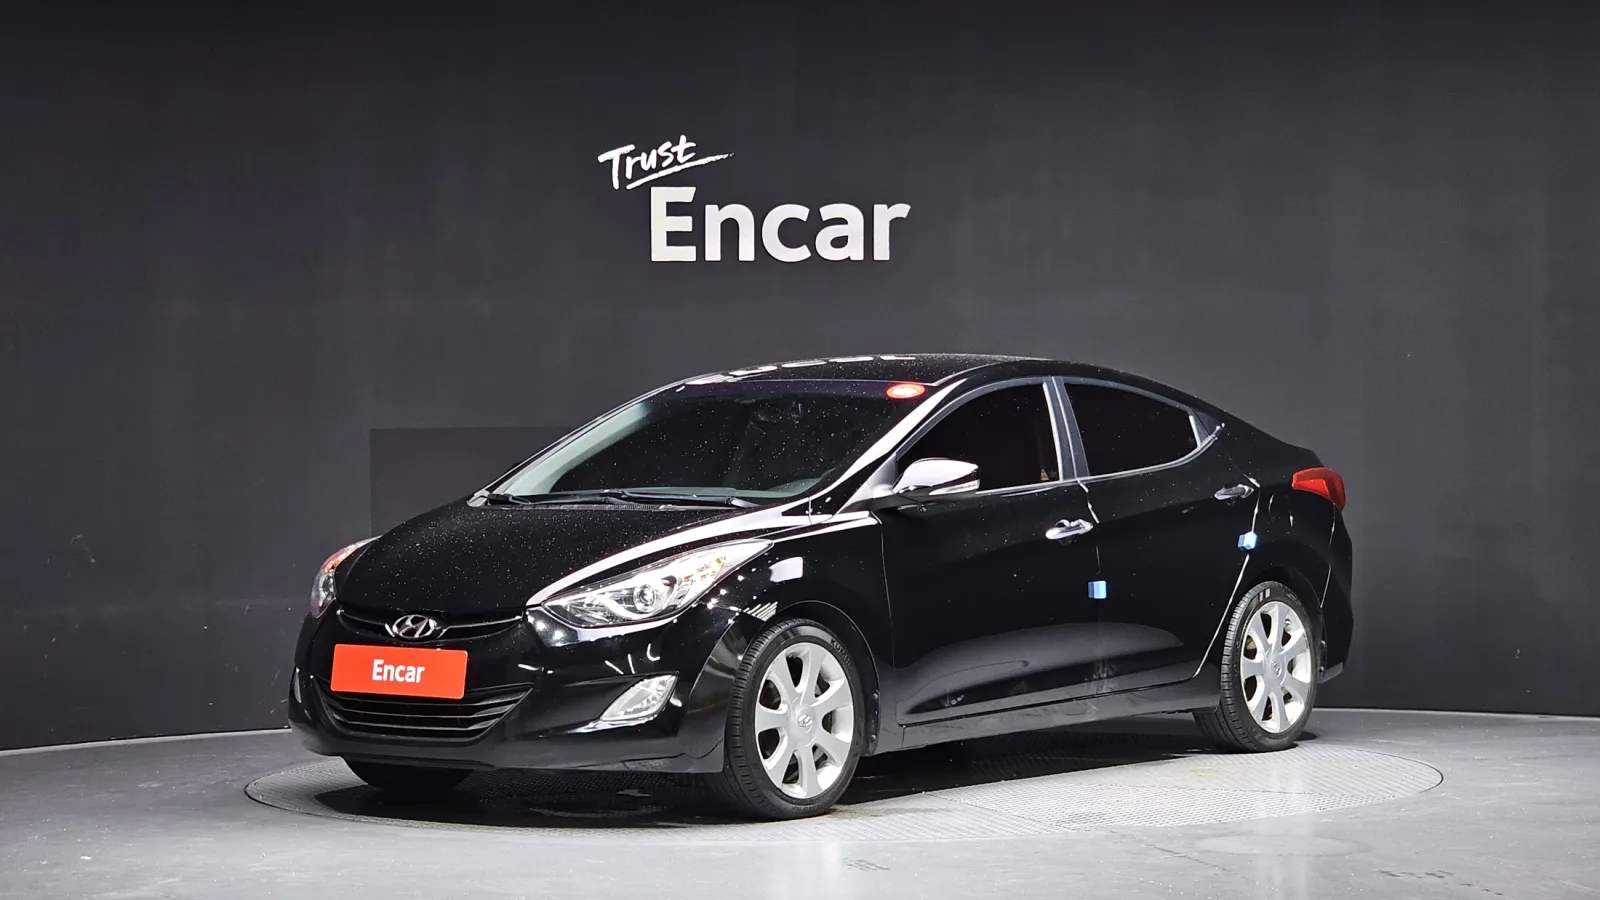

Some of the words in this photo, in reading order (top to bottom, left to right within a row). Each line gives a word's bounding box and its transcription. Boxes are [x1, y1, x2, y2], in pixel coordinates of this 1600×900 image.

[597, 134, 697, 190] Trust
[650, 186, 911, 263] Encar
[371, 658, 426, 684] Encar
